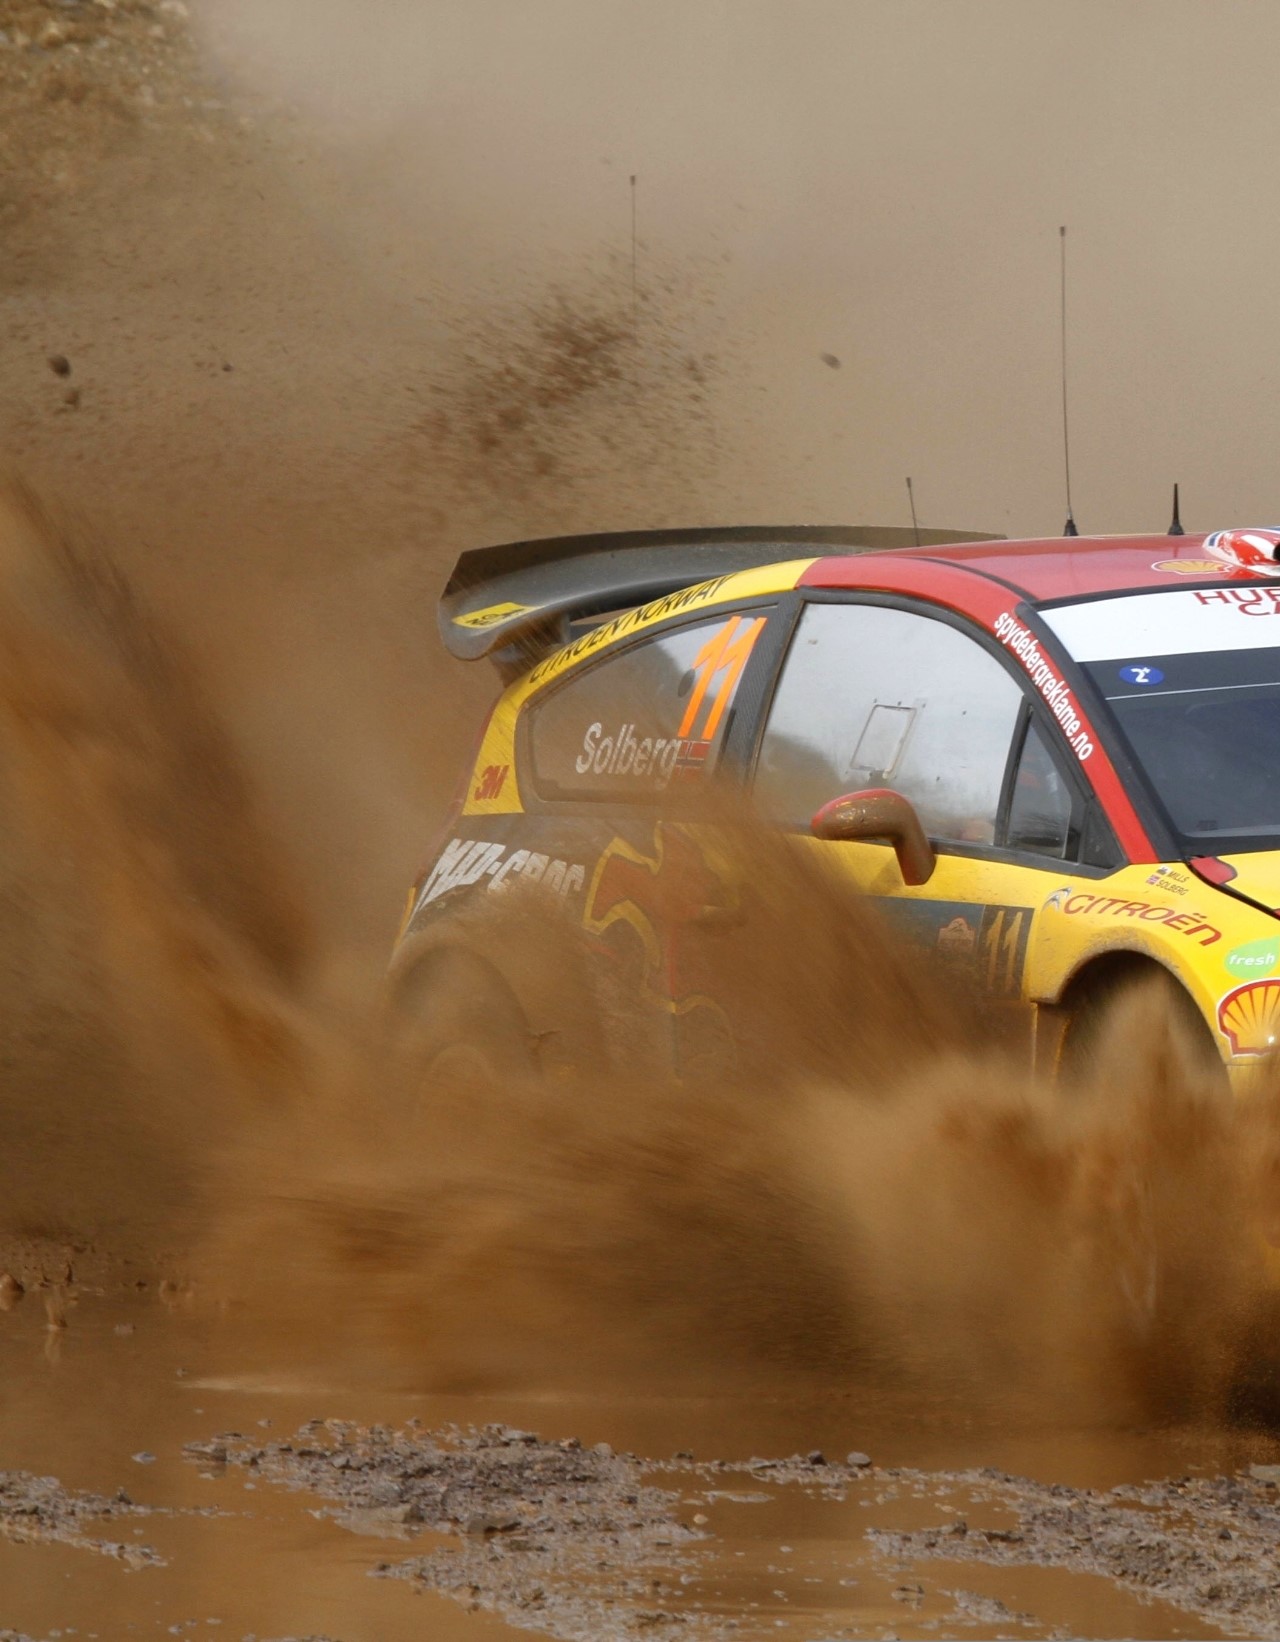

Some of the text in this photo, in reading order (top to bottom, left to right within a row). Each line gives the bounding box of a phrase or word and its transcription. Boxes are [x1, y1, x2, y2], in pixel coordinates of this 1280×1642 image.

[622, 573, 737, 630] NORWAY
[677, 615, 768, 740] 11
[993, 612, 1094, 761] spydebergreklame.no
[575, 722, 682, 789] Solberg
[474, 764, 510, 801] 3M
[1155, 879, 1190, 896] SOLBERG
[1166, 870, 1190, 884] MILLS
[1229, 952, 1275, 966] fresh
